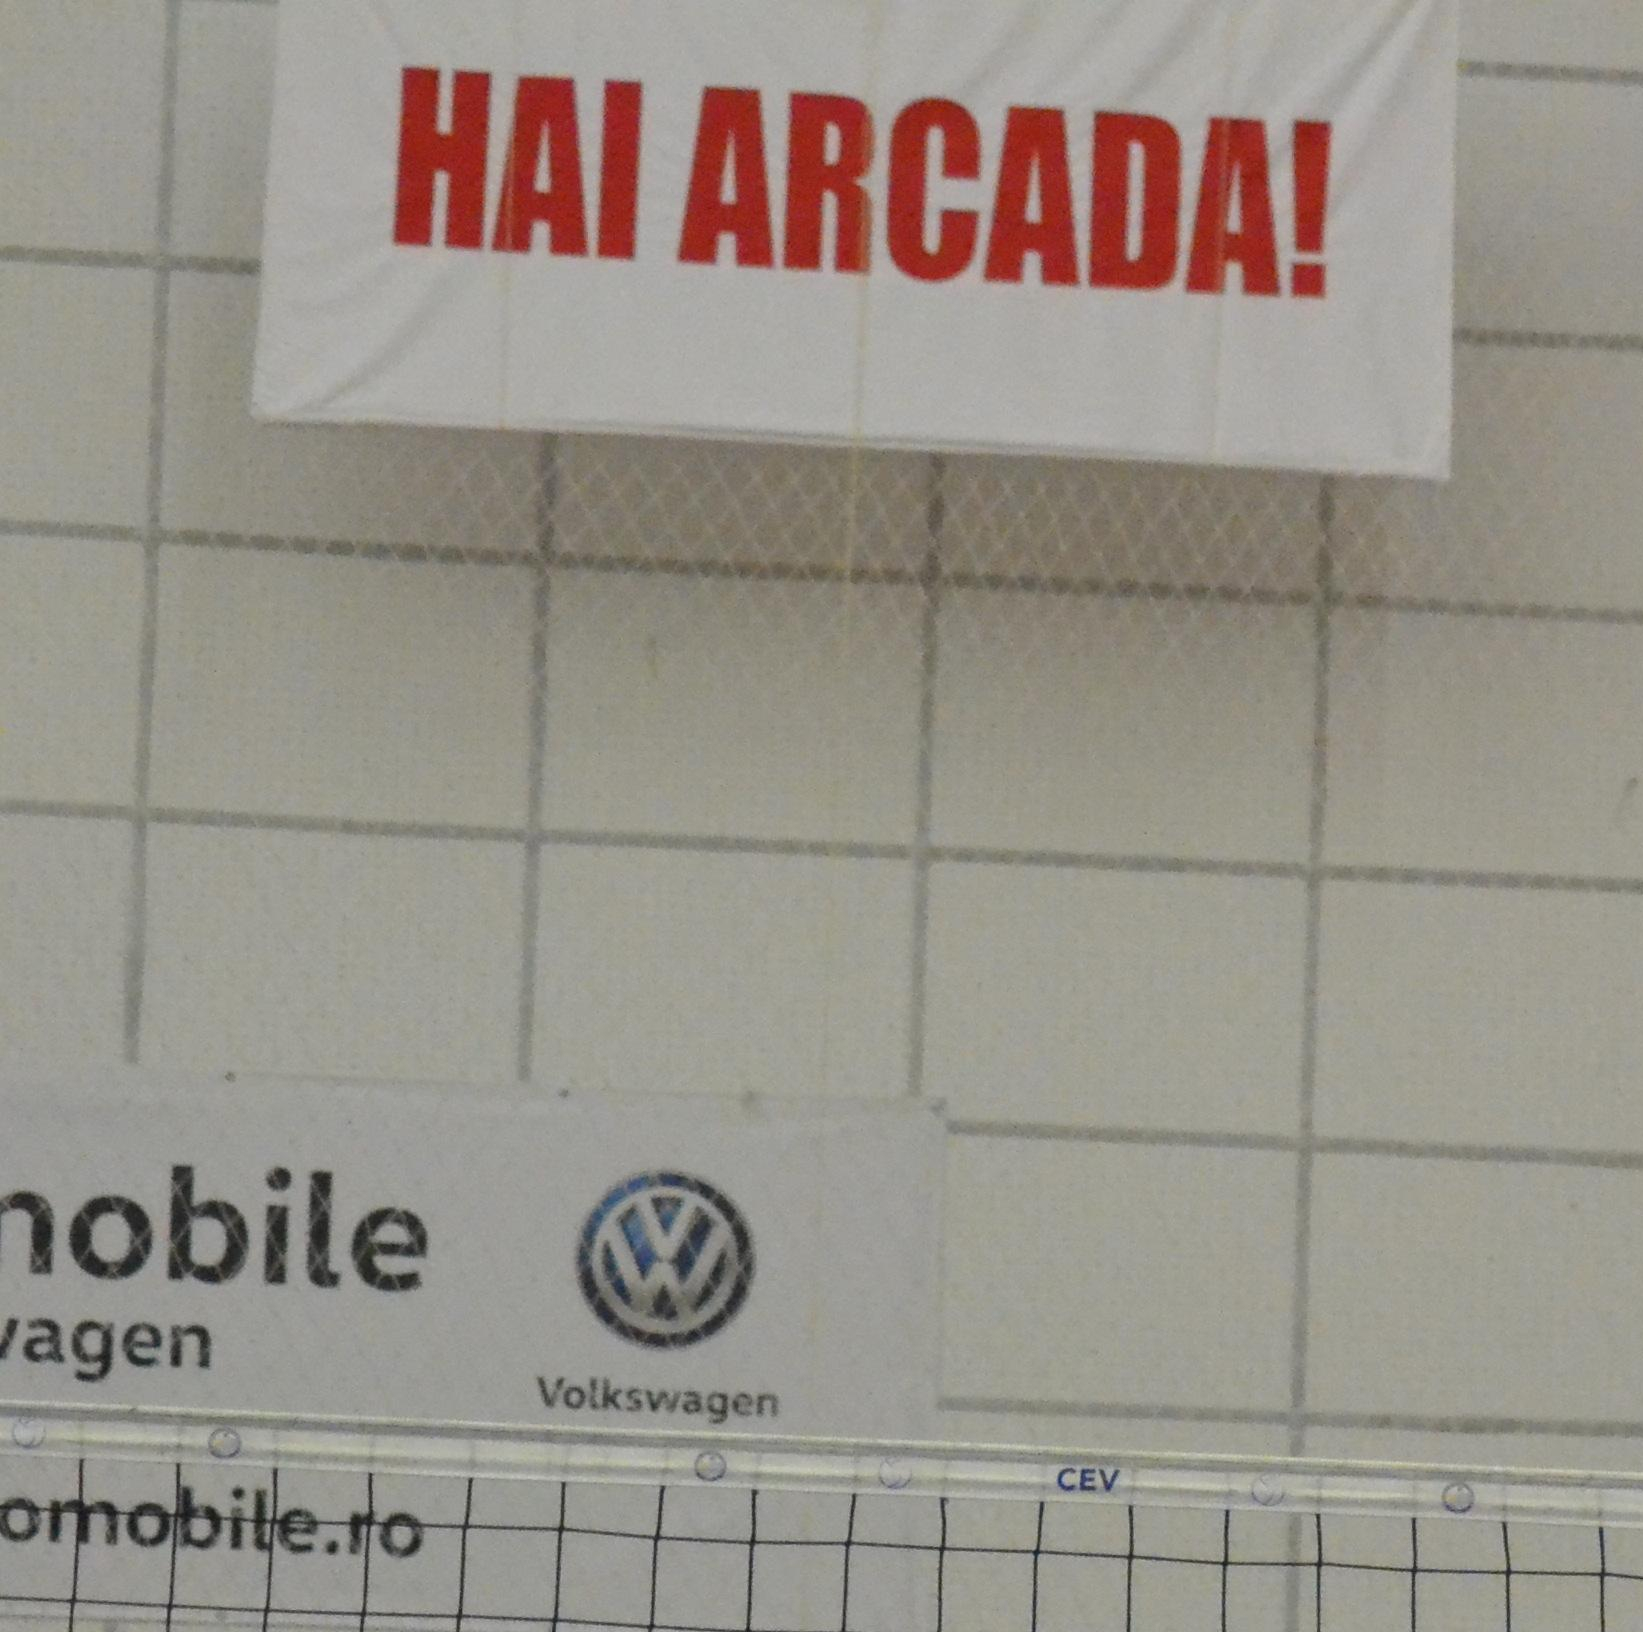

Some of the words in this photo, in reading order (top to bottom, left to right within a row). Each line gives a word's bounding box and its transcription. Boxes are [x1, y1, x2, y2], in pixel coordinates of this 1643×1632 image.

[392, 67, 645, 261] HAI
[678, 85, 1332, 299] ARCADA!
[537, 1376, 780, 1421] Volkswagen
[1057, 1467, 1120, 1493] CEV
